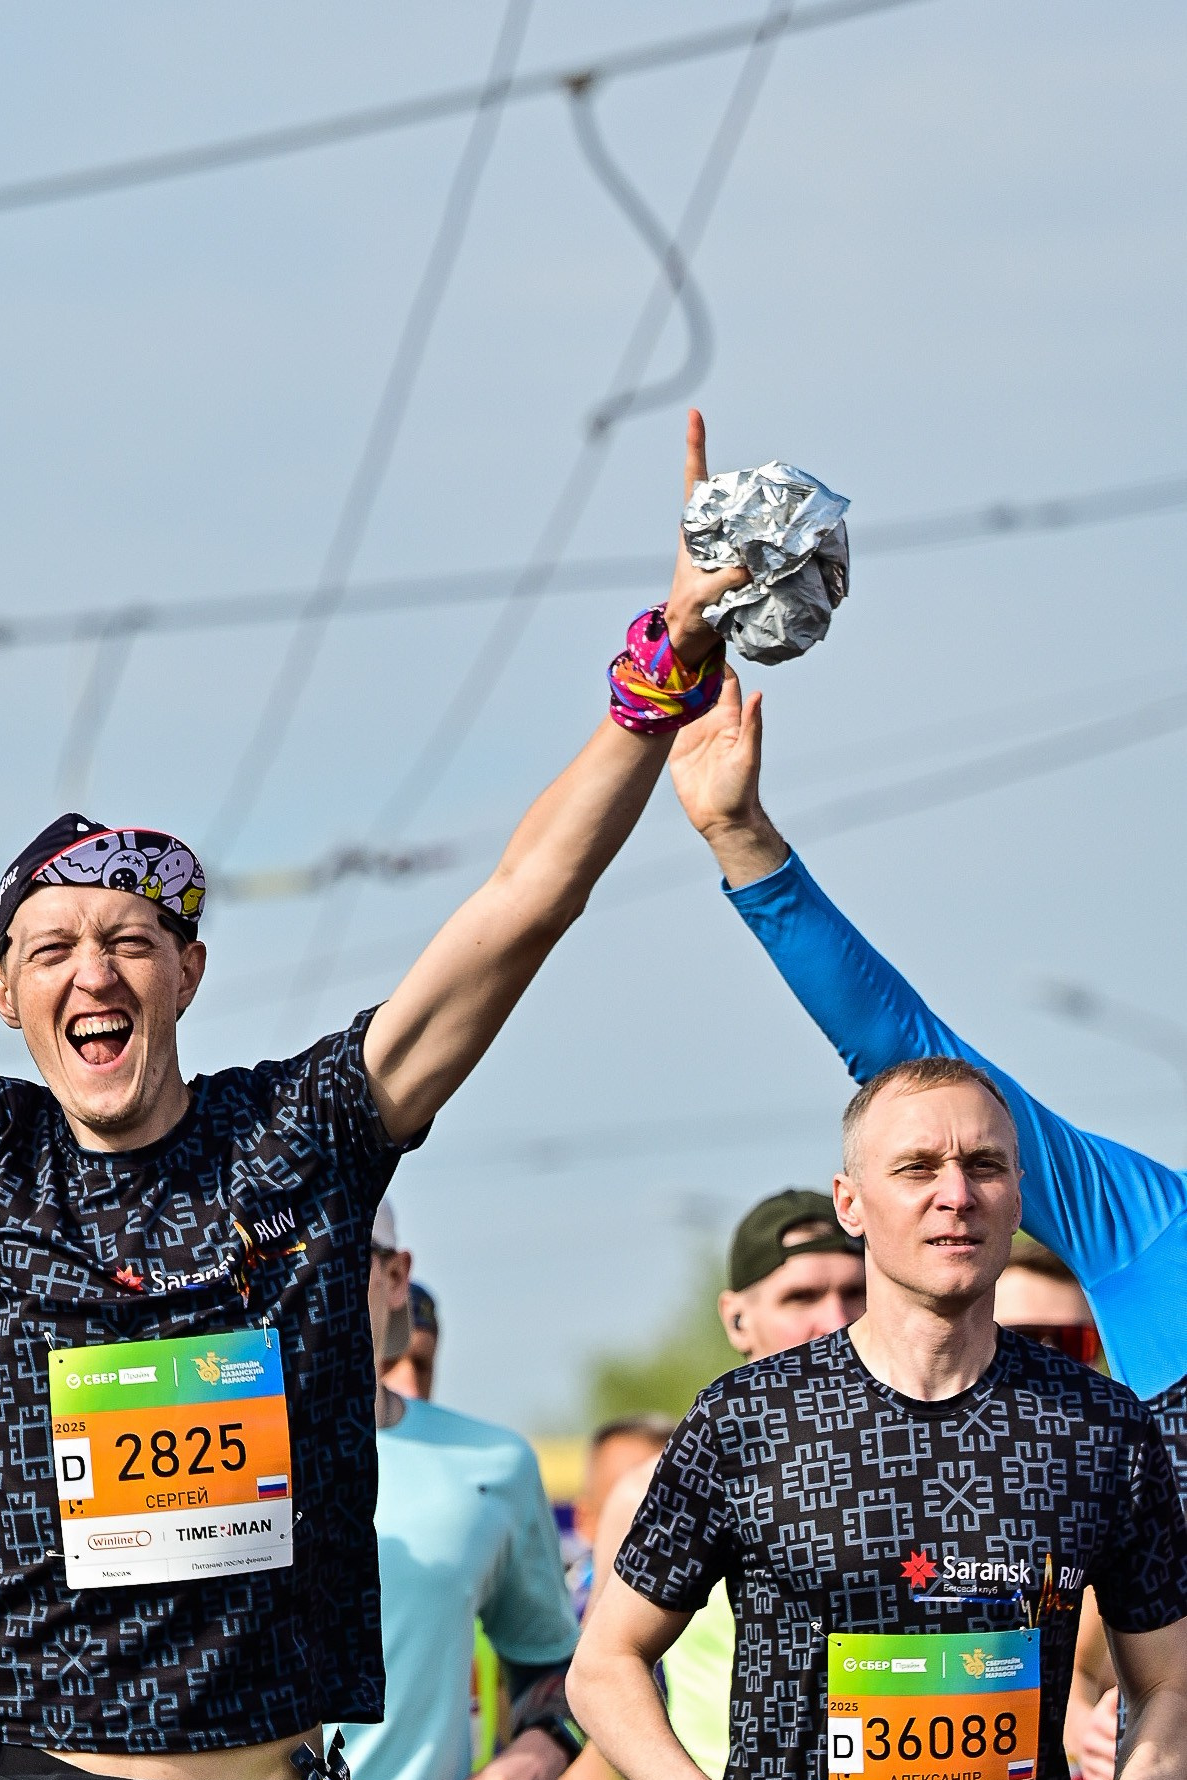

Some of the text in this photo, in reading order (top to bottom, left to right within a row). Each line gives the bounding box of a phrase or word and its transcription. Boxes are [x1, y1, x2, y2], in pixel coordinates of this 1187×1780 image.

[254, 1207, 296, 1243] RUN
[83, 1372, 118, 1386] СБЕР
[220, 1366, 265, 1378] КАЗАНСКИЙ
[221, 1375, 257, 1385] МАРАФОН
[55, 1421, 86, 1434] 2025
[114, 1422, 247, 1482] 2825
[61, 1455, 86, 1482] D
[145, 1486, 209, 1509] СЕРГЕЙ
[93, 1535, 134, 1547] Winline
[942, 1556, 1031, 1584] Saransk
[858, 1660, 890, 1671] СБЕР
[830, 1702, 859, 1712] 2025
[833, 1712, 1018, 1760] D 36088
